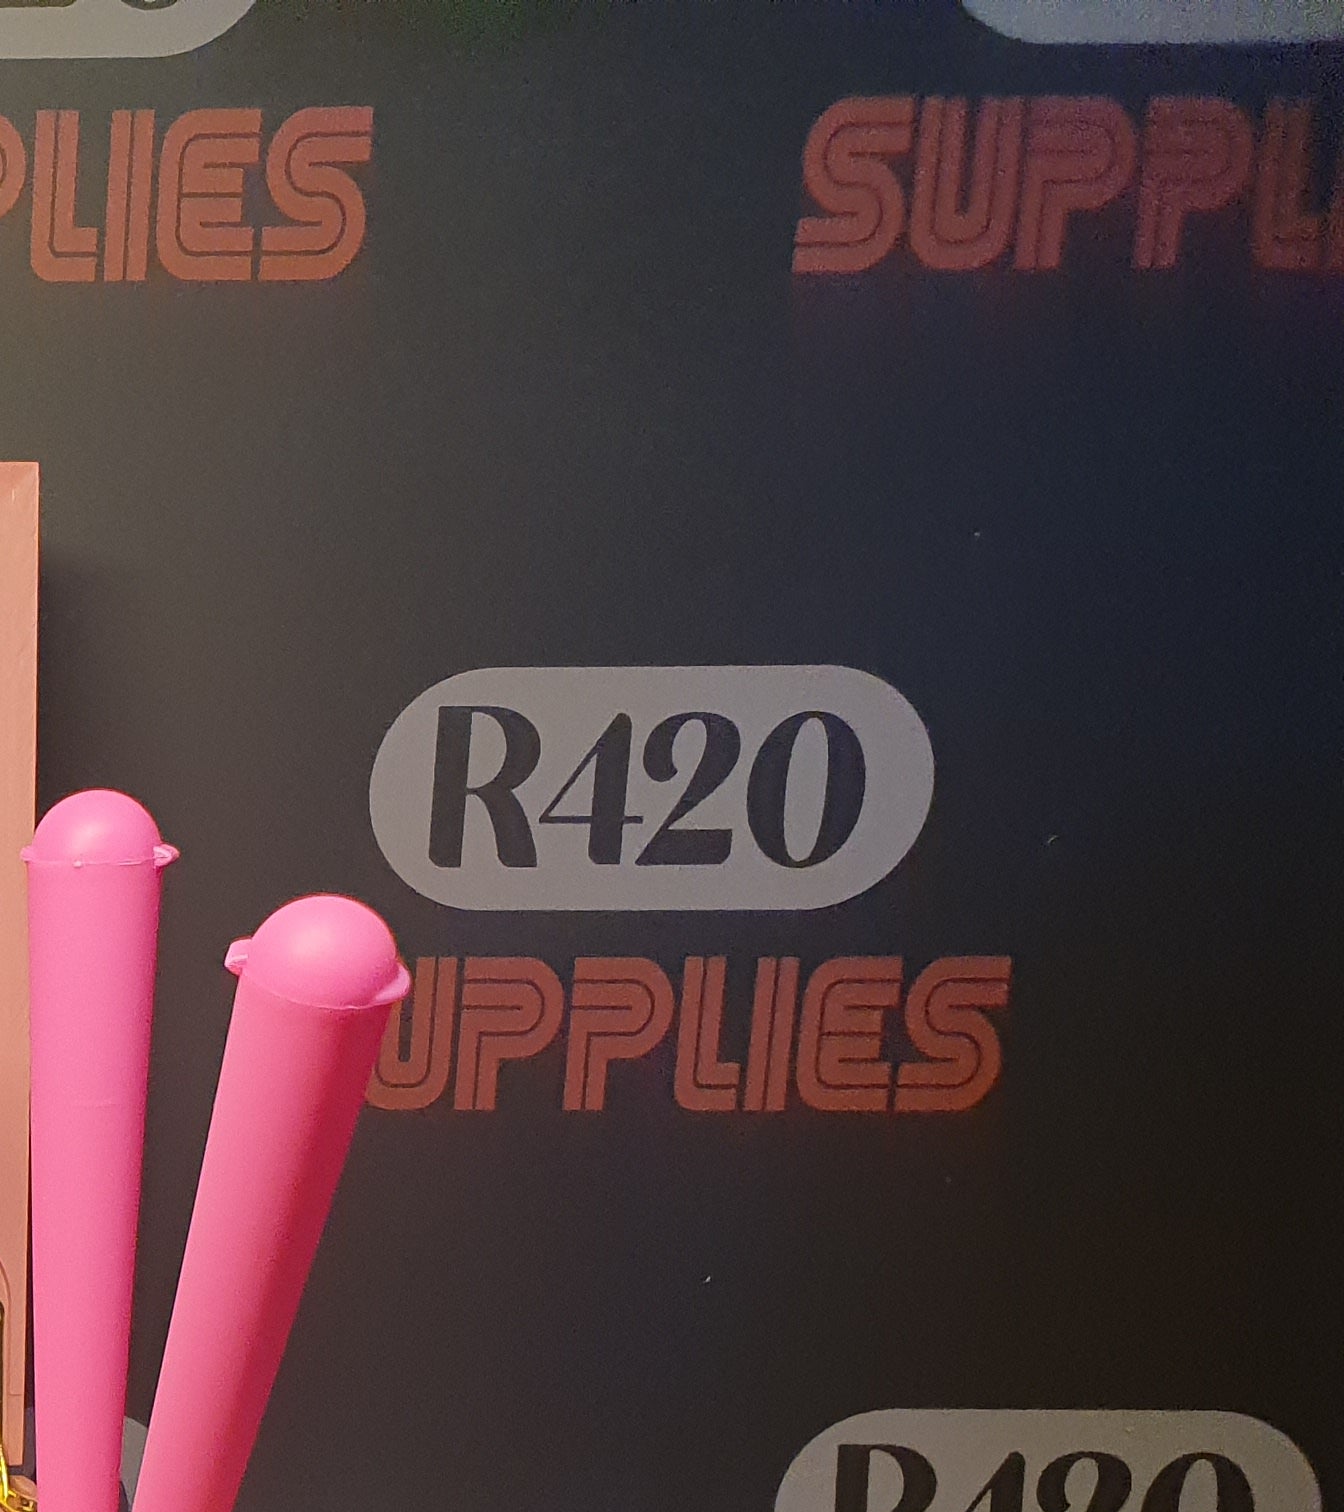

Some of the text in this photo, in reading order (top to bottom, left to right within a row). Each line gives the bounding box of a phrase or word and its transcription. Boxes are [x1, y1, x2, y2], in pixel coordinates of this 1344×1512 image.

[792, 95, 1344, 273] SUPPL
[428, 705, 866, 869] R420
[365, 955, 1011, 1112] UPPLIES
